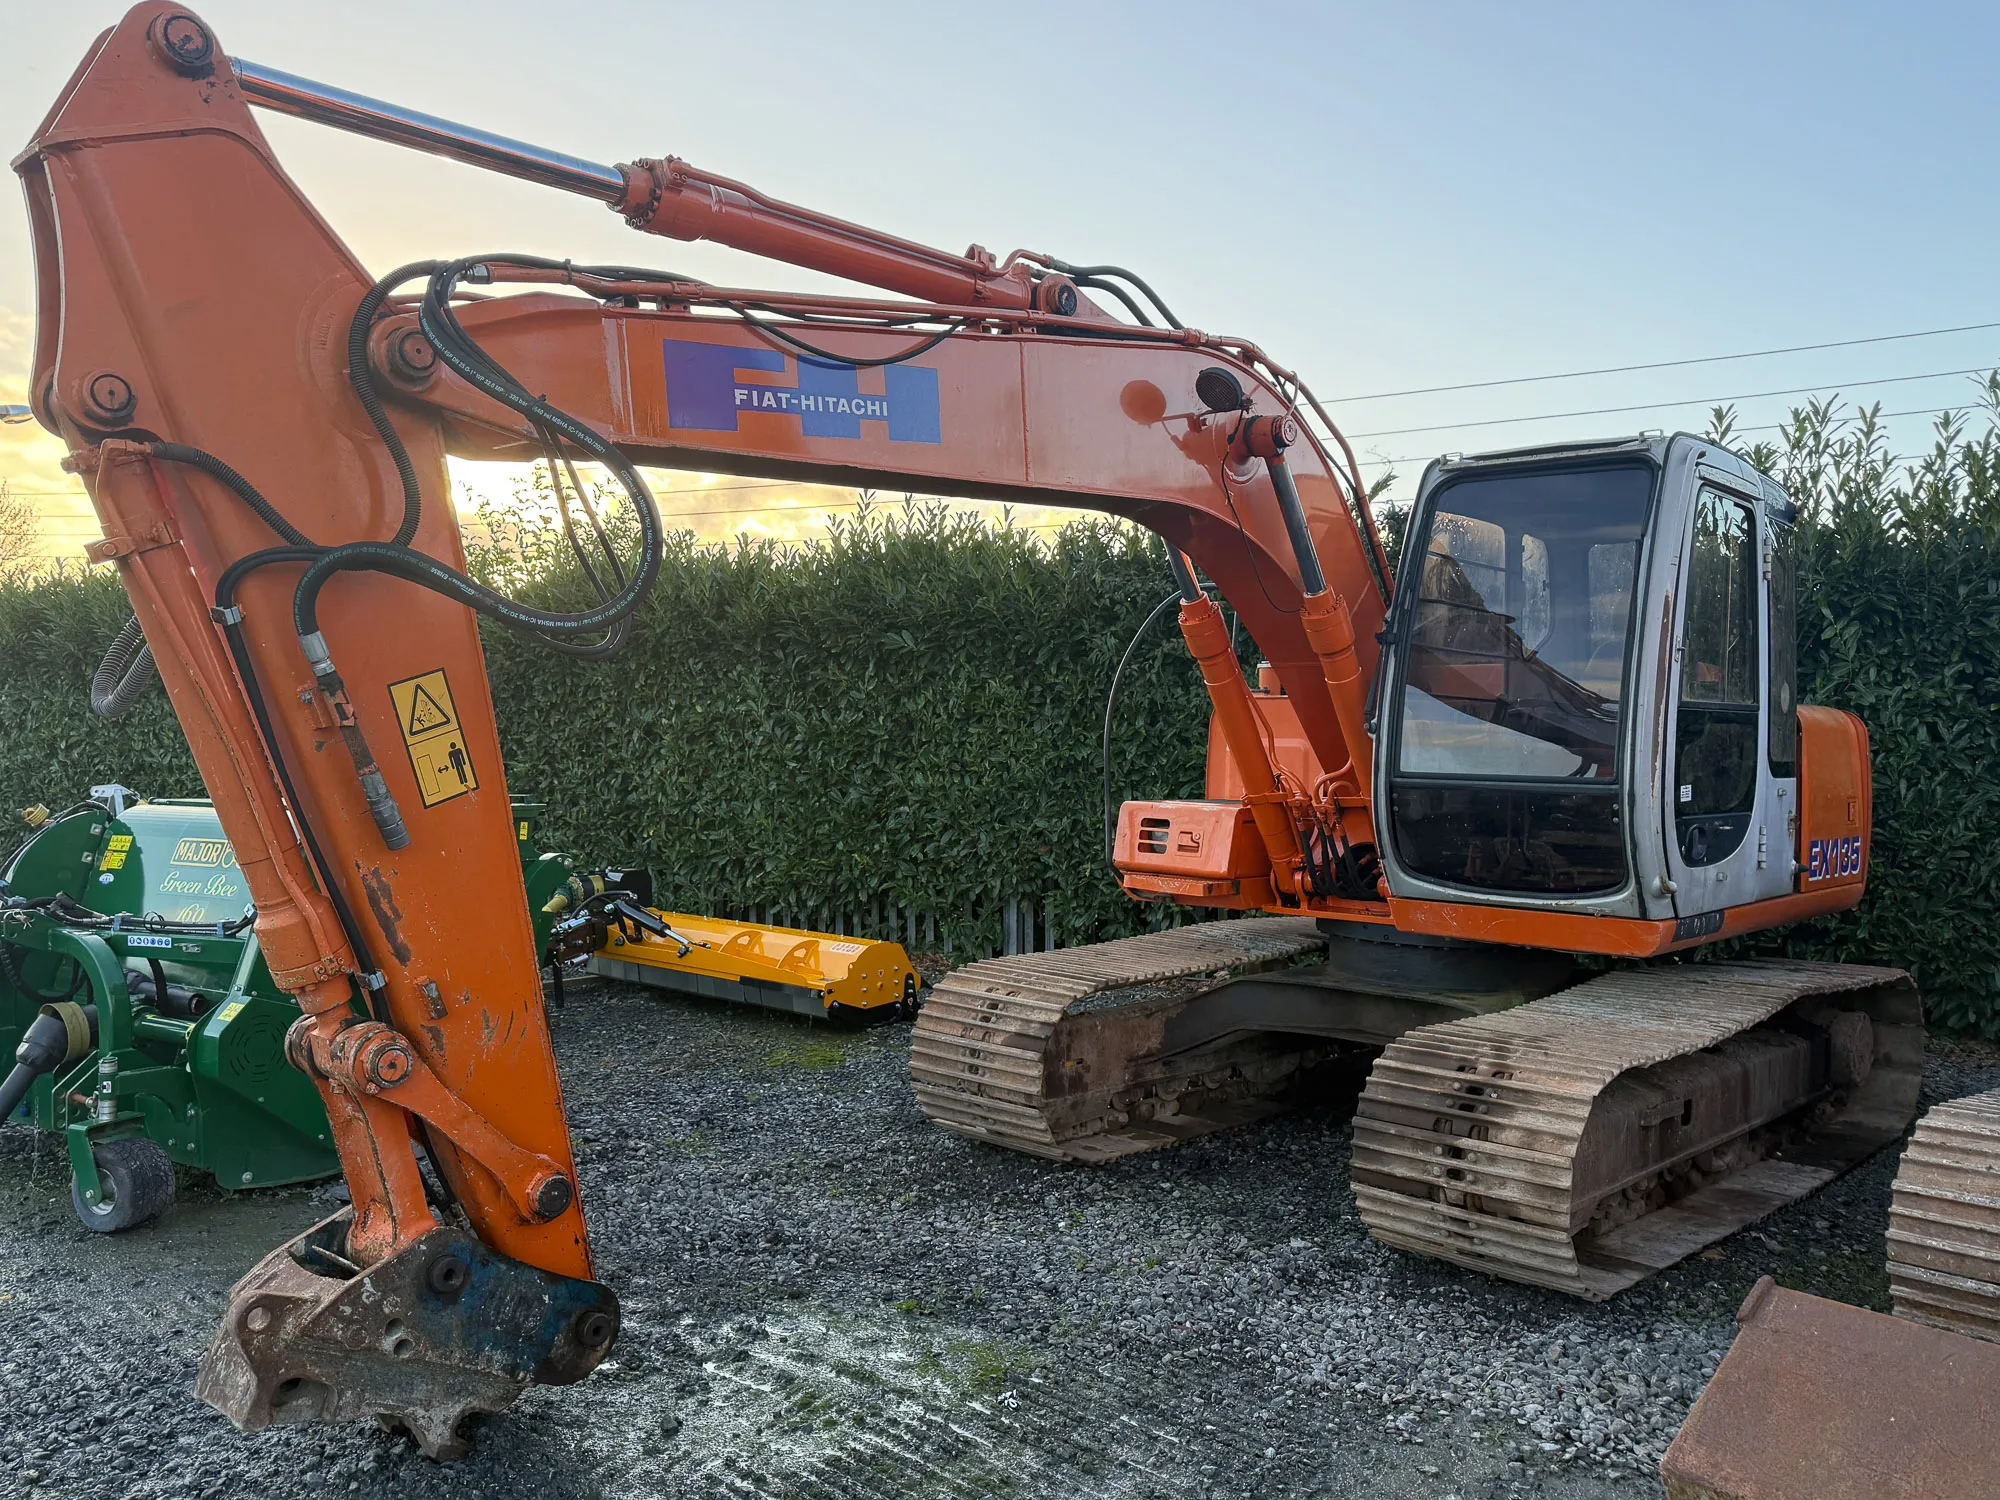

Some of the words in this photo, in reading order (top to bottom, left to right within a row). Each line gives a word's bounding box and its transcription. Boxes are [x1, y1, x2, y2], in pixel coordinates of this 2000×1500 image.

[484, 379, 495, 388] 32.0
[508, 393, 519, 402] 320
[552, 416, 568, 428] MSHA
[733, 388, 889, 417] FIAT-HITACHI
[174, 841, 222, 863] MAJOR
[1808, 835, 1861, 881] EX135
[160, 870, 202, 894] Green
[204, 873, 239, 897] Bee
[175, 903, 205, 922] 160
